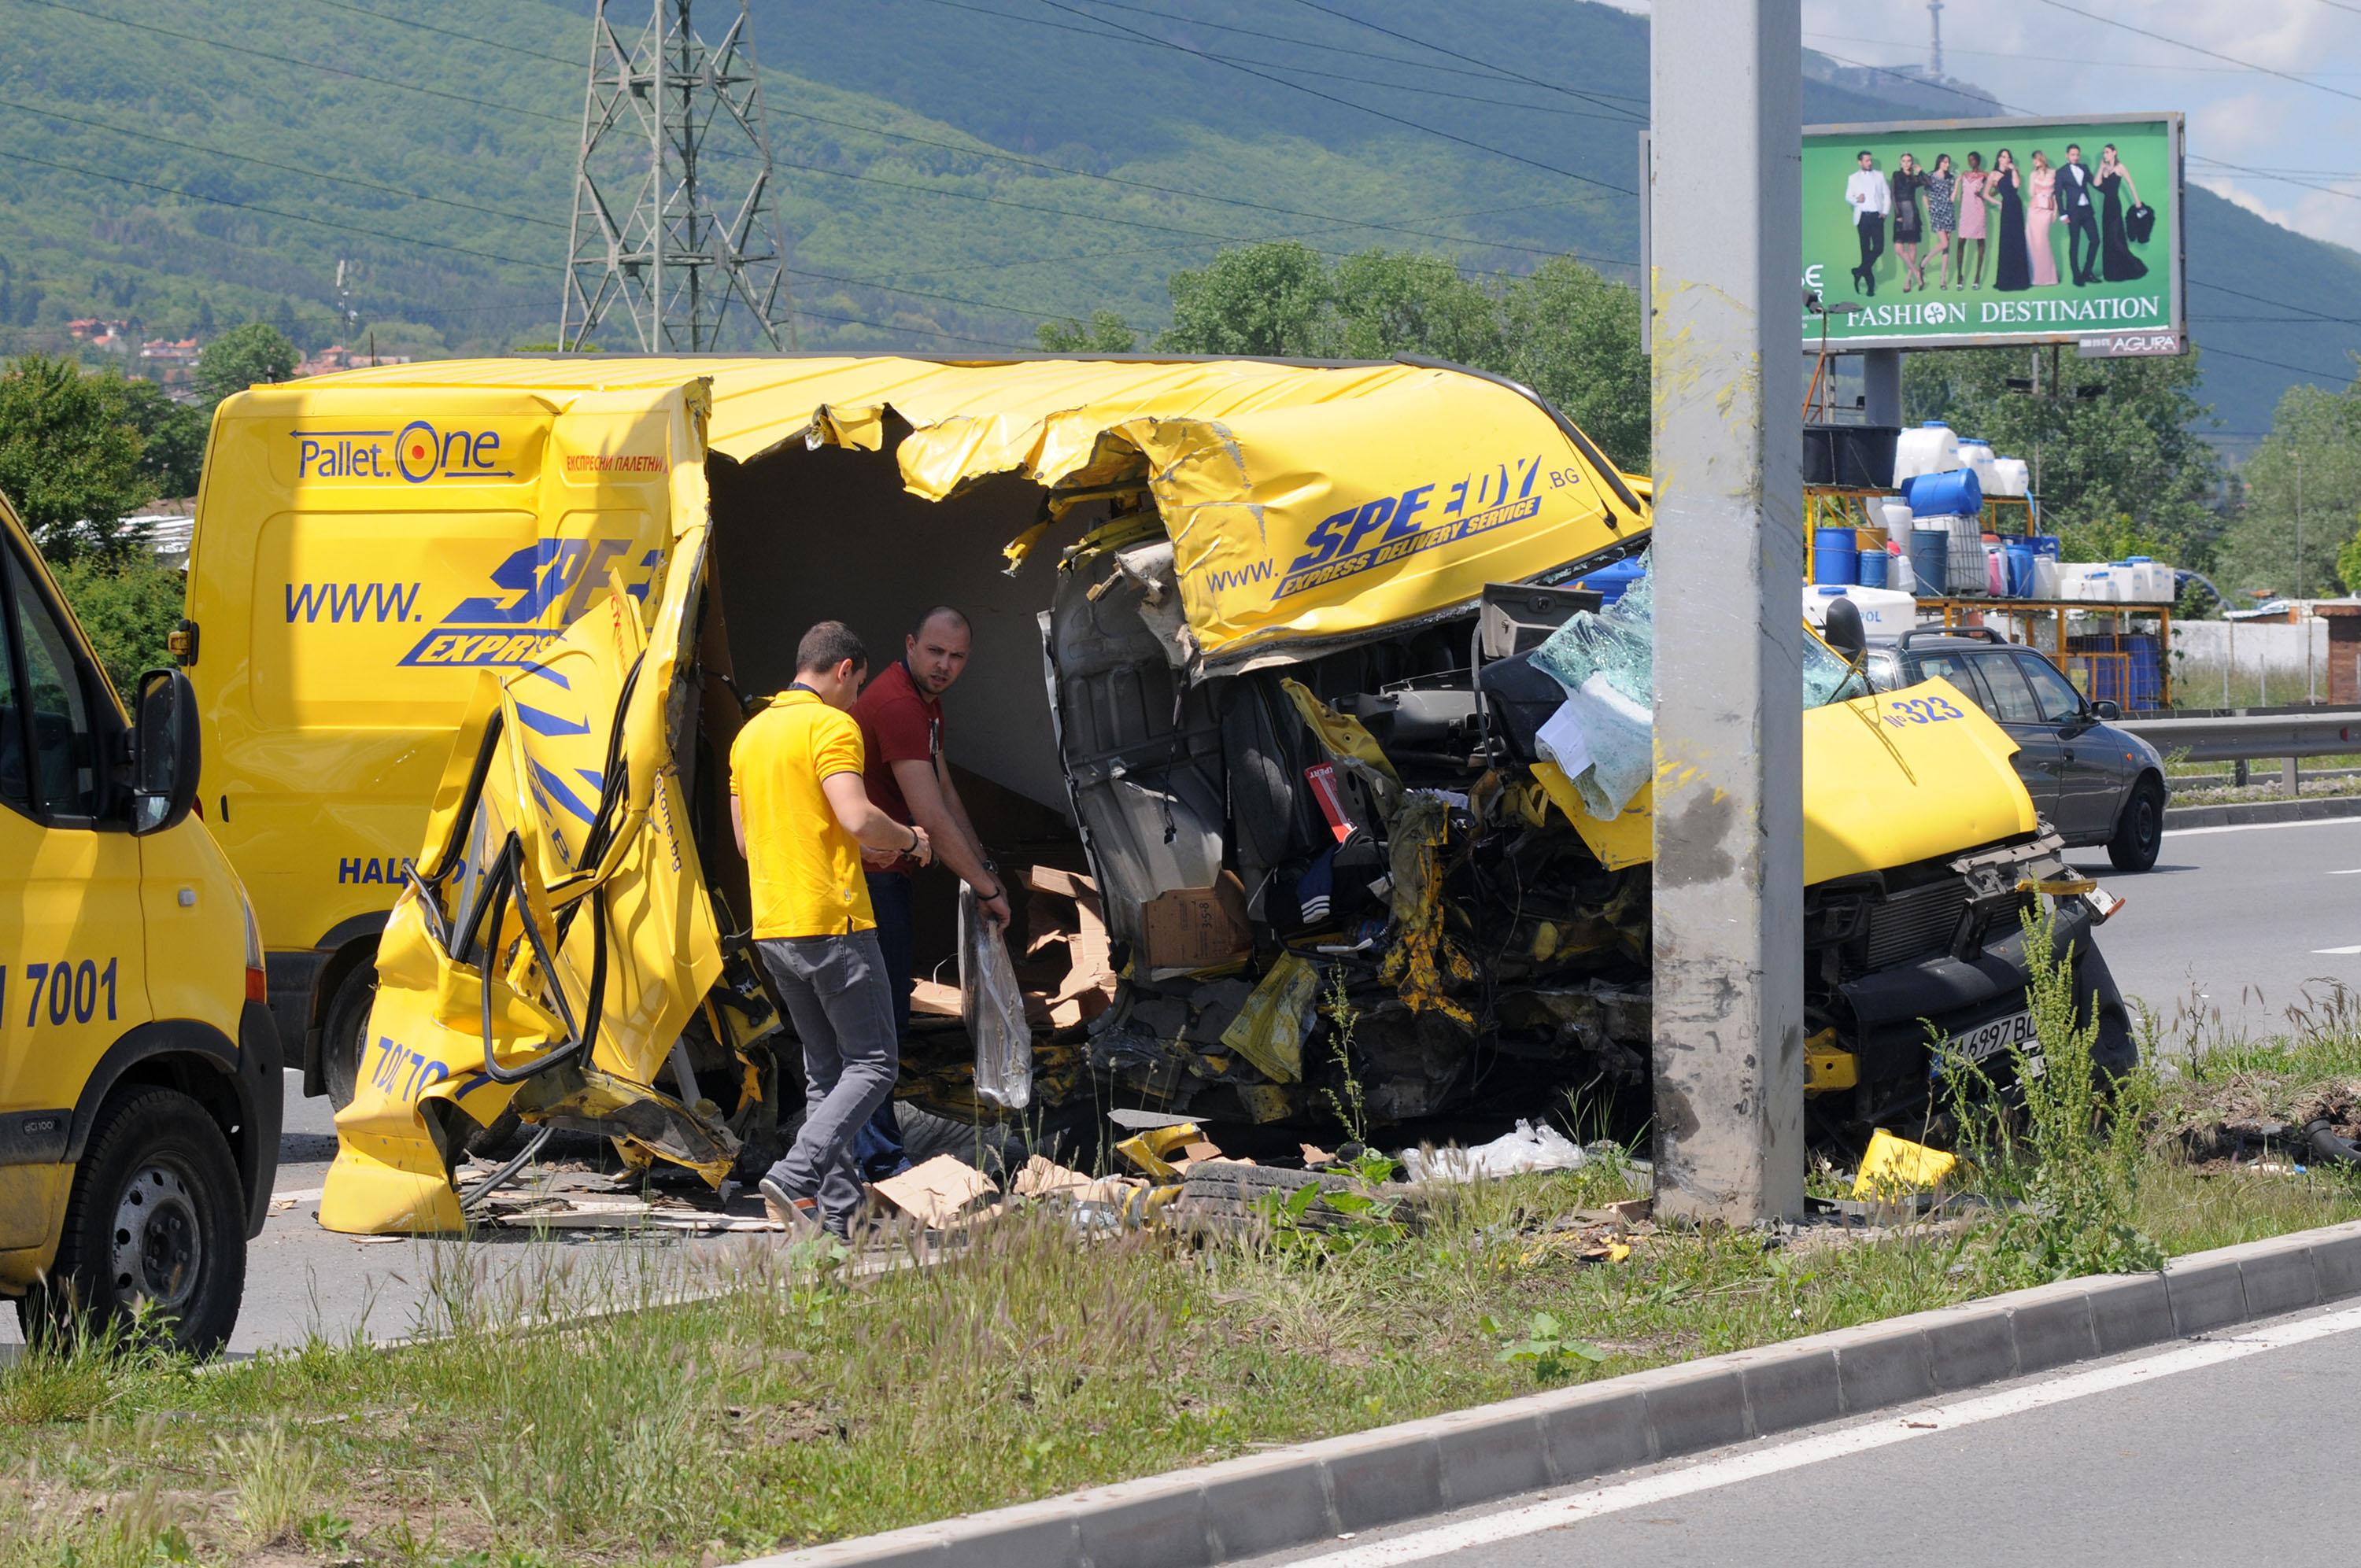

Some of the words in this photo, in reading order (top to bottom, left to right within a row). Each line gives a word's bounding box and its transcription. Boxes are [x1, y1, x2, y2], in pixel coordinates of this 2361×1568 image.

[1980, 296, 2160, 323] DESTINATION
[567, 456, 613, 472] ЕКСПРЕСНИ
[615, 456, 663, 472] ПАЛЕТНИ
[1550, 467, 1580, 489] .BG
[1281, 553, 1372, 596] EXPRESS
[1373, 521, 1465, 567] DELIVERY
[1465, 498, 1536, 534] SERVICE
[1860, 611, 1882, 622] OL
[26, 957, 117, 1028] 7001
[1968, 1020, 2012, 1057] 6997
